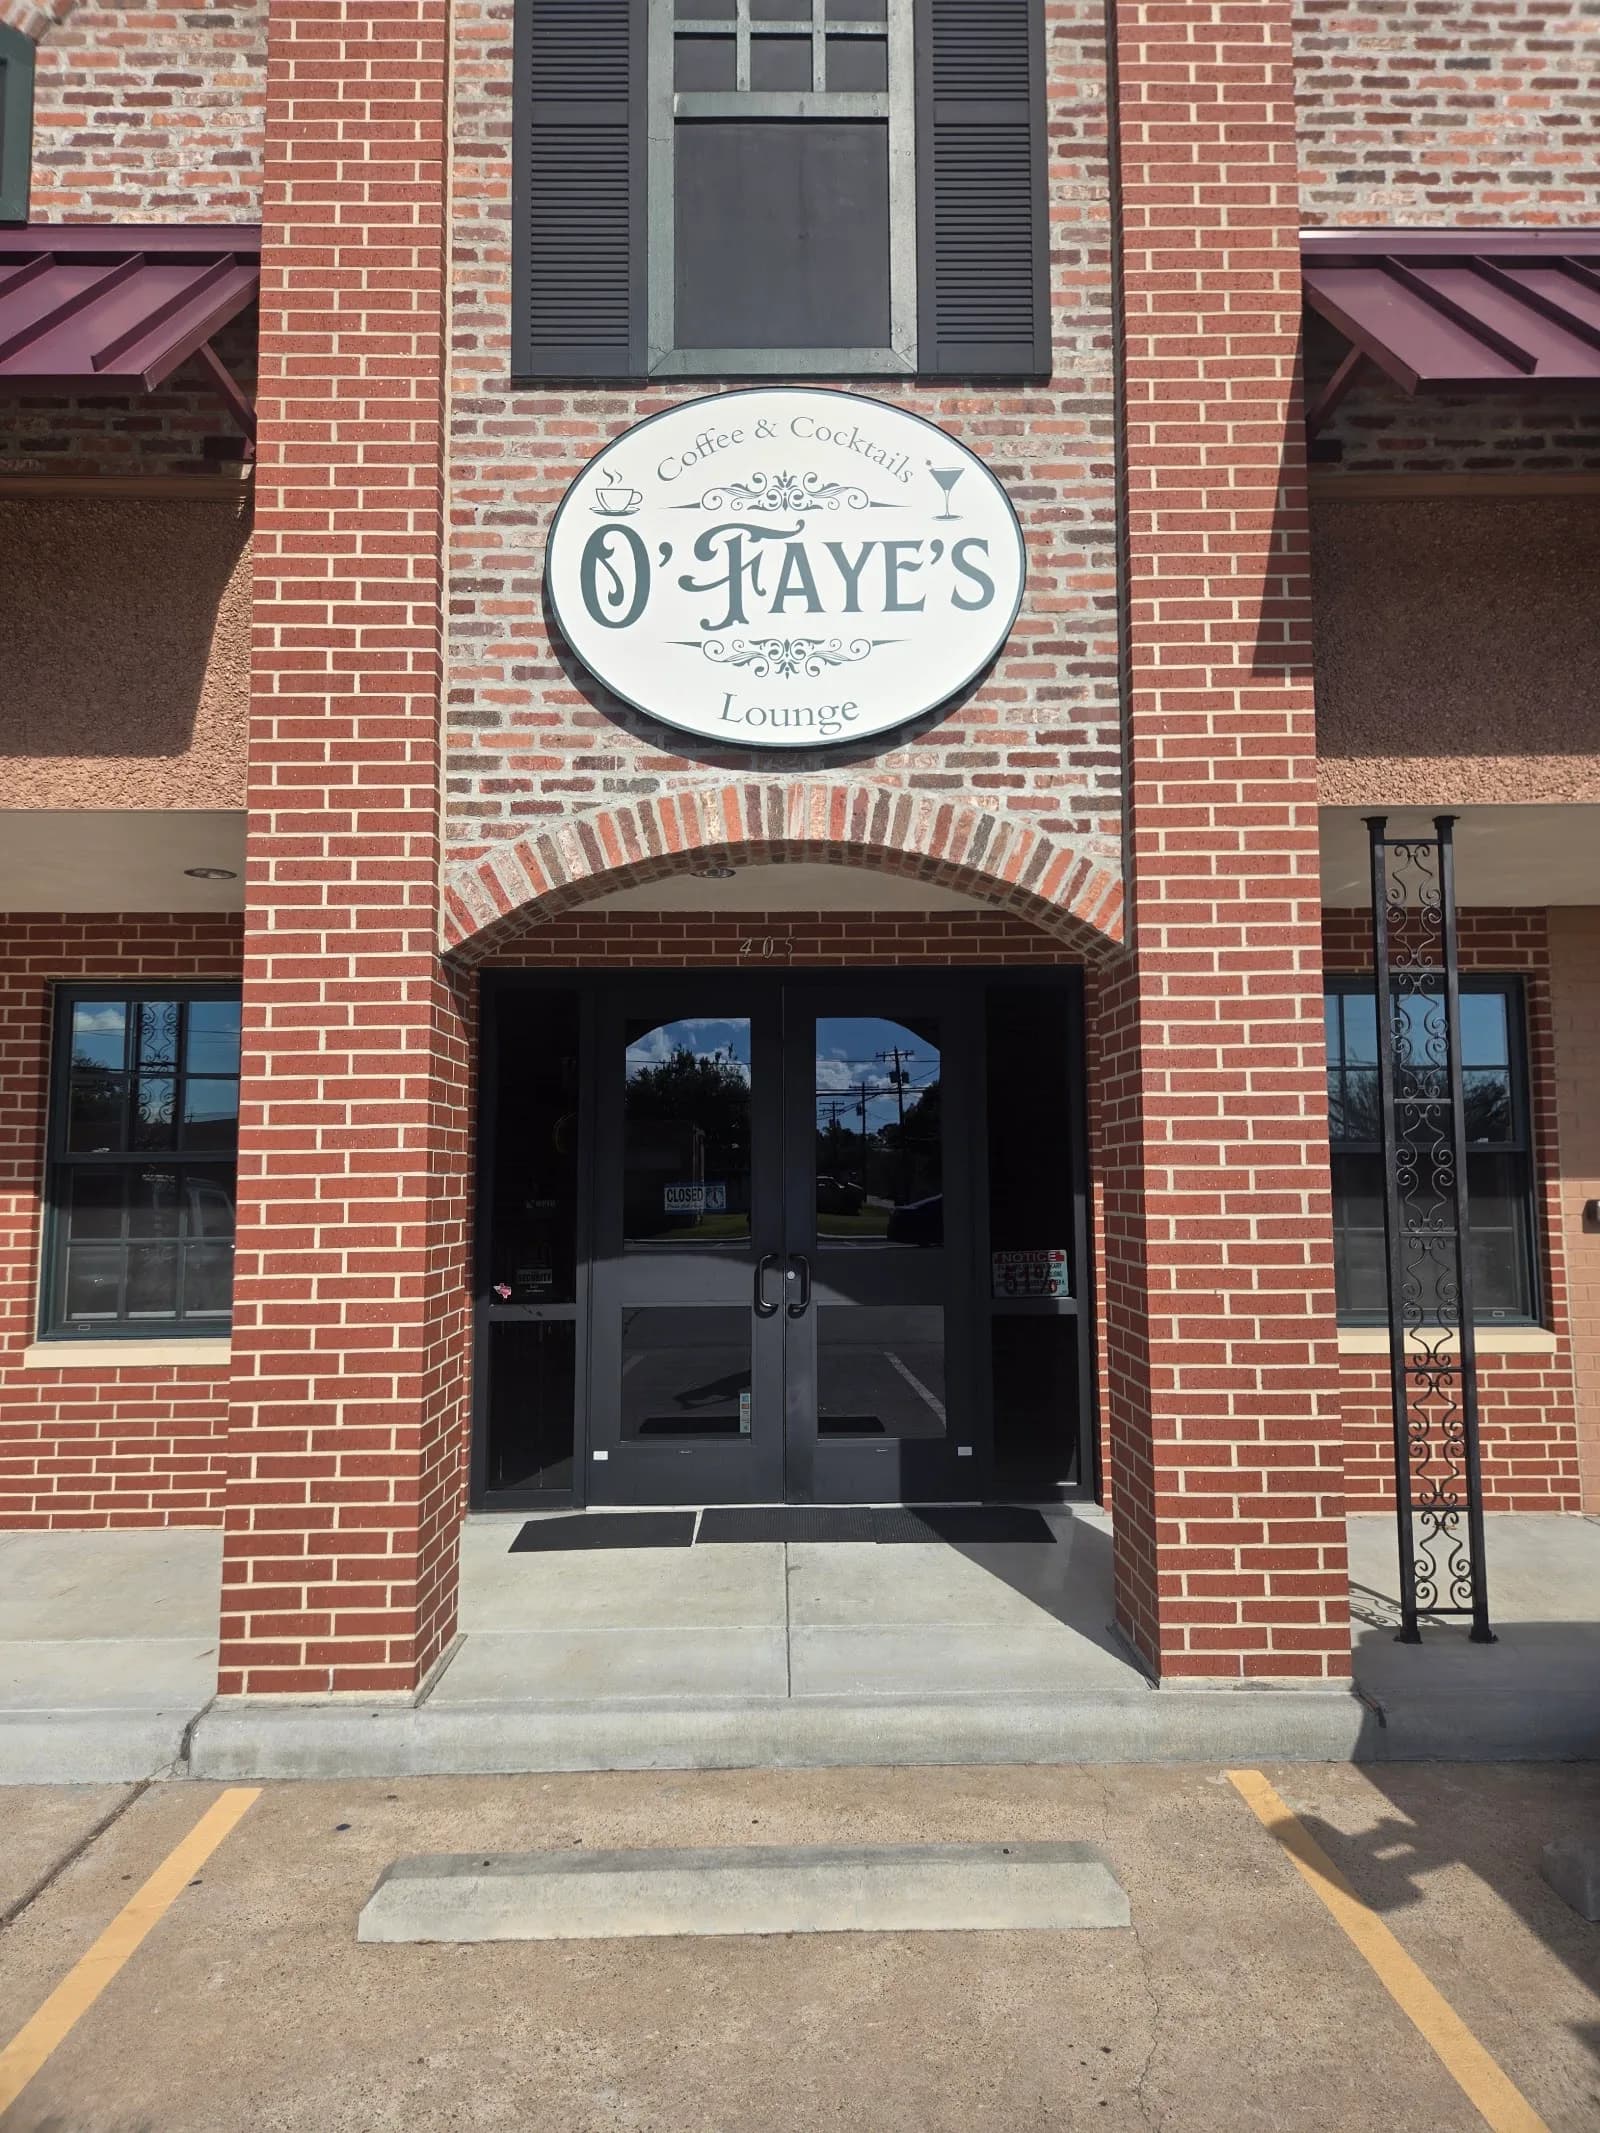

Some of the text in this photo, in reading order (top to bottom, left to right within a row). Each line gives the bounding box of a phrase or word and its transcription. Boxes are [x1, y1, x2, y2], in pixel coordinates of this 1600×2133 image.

[657, 416, 914, 485] Coffee & Cocktails
[718, 692, 860, 735] Lounge
[739, 936, 796, 959] 405
[666, 1187, 704, 1203] CLOSED
[1001, 1252, 1057, 1263] NOTICE
